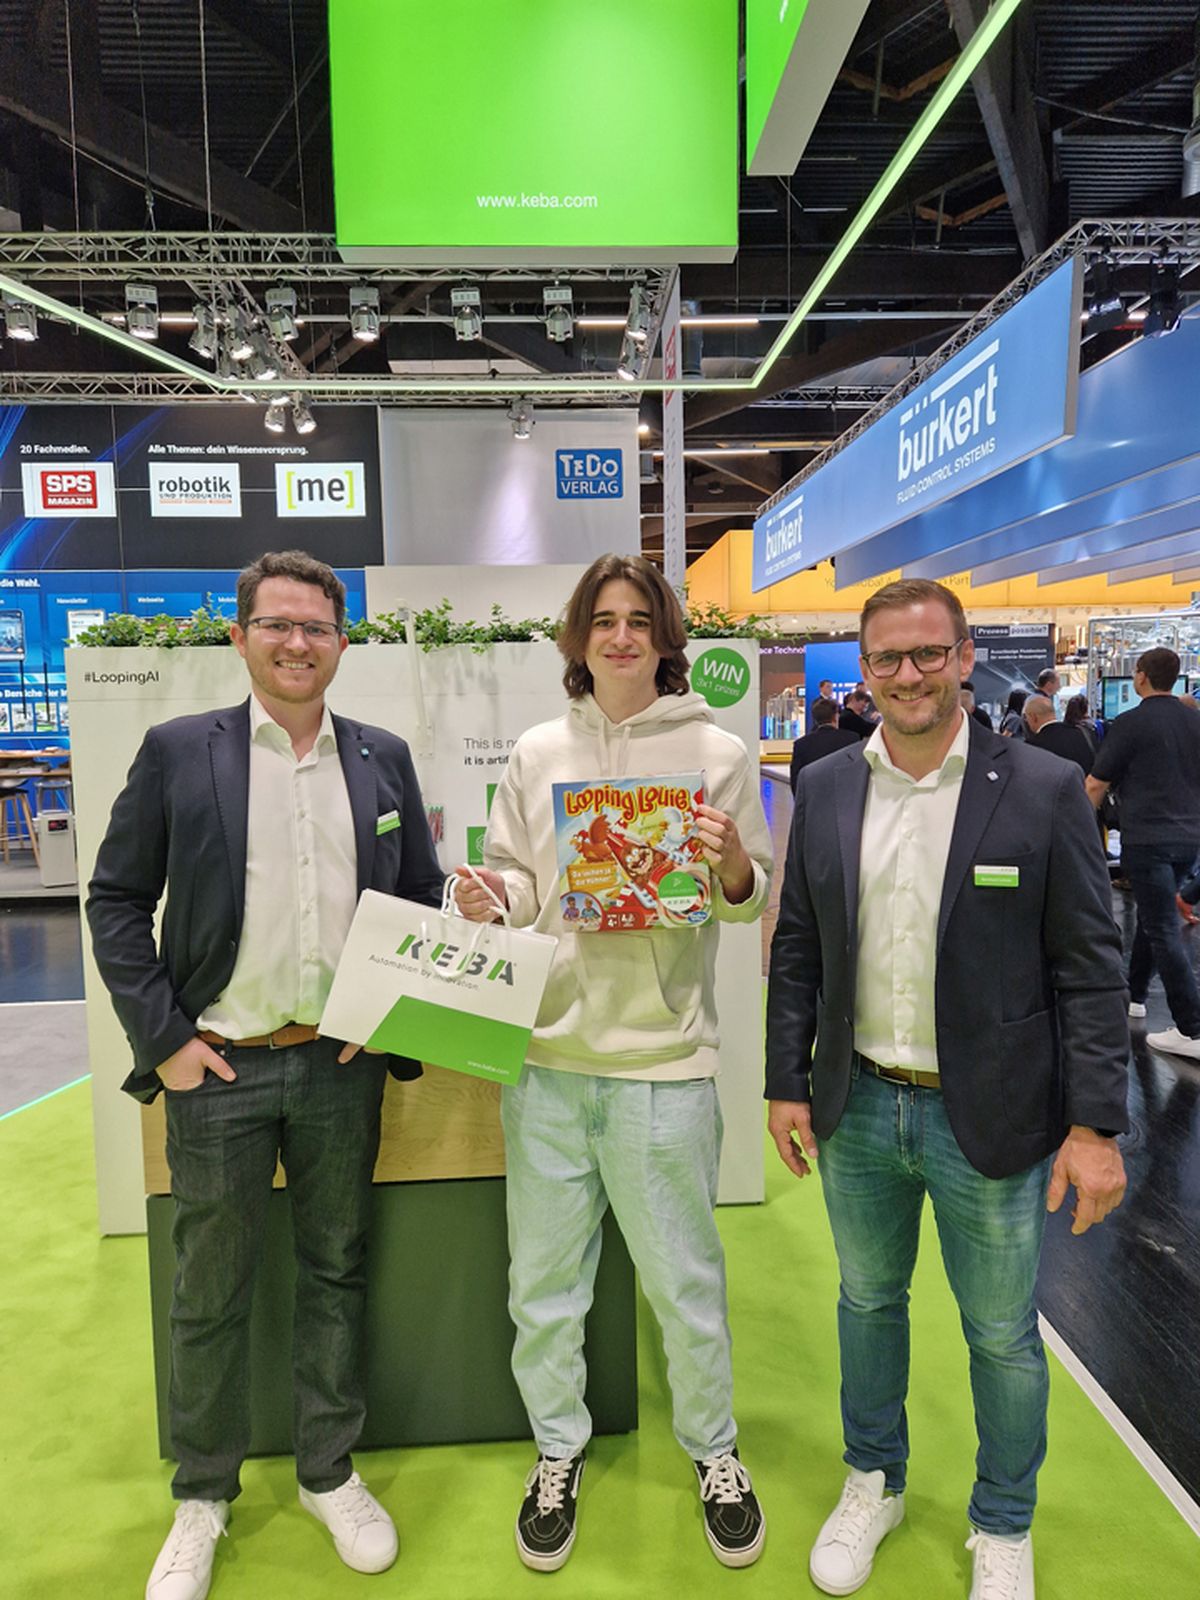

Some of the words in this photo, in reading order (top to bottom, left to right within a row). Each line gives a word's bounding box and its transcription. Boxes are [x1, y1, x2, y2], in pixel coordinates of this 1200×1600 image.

[476, 192, 598, 208] www.keba.com
[20, 445, 32, 454] 20
[34, 444, 91, 454] Fachmedien.
[148, 444, 165, 454] Alle
[167, 444, 205, 454] Themen:
[206, 444, 226, 454] dein
[227, 444, 309, 456] Wissensvorsprung.
[954, 436, 996, 474] SYSTEMS
[46, 475, 93, 493] SPS
[158, 476, 232, 493] robotik
[560, 480, 619, 494] VERLAG
[15, 578, 41, 588] Wahl.
[84, 670, 160, 686] #LoopingAI
[703, 657, 745, 685] WIN
[464, 737, 490, 750] This
[493, 737, 504, 750] is
[464, 754, 472, 766] it
[474, 754, 485, 766] is
[563, 783, 638, 824] Looping
[636, 784, 691, 818] Louie
[368, 954, 420, 974] Automation
[420, 968, 433, 980] by
[396, 933, 515, 987] KEBA
